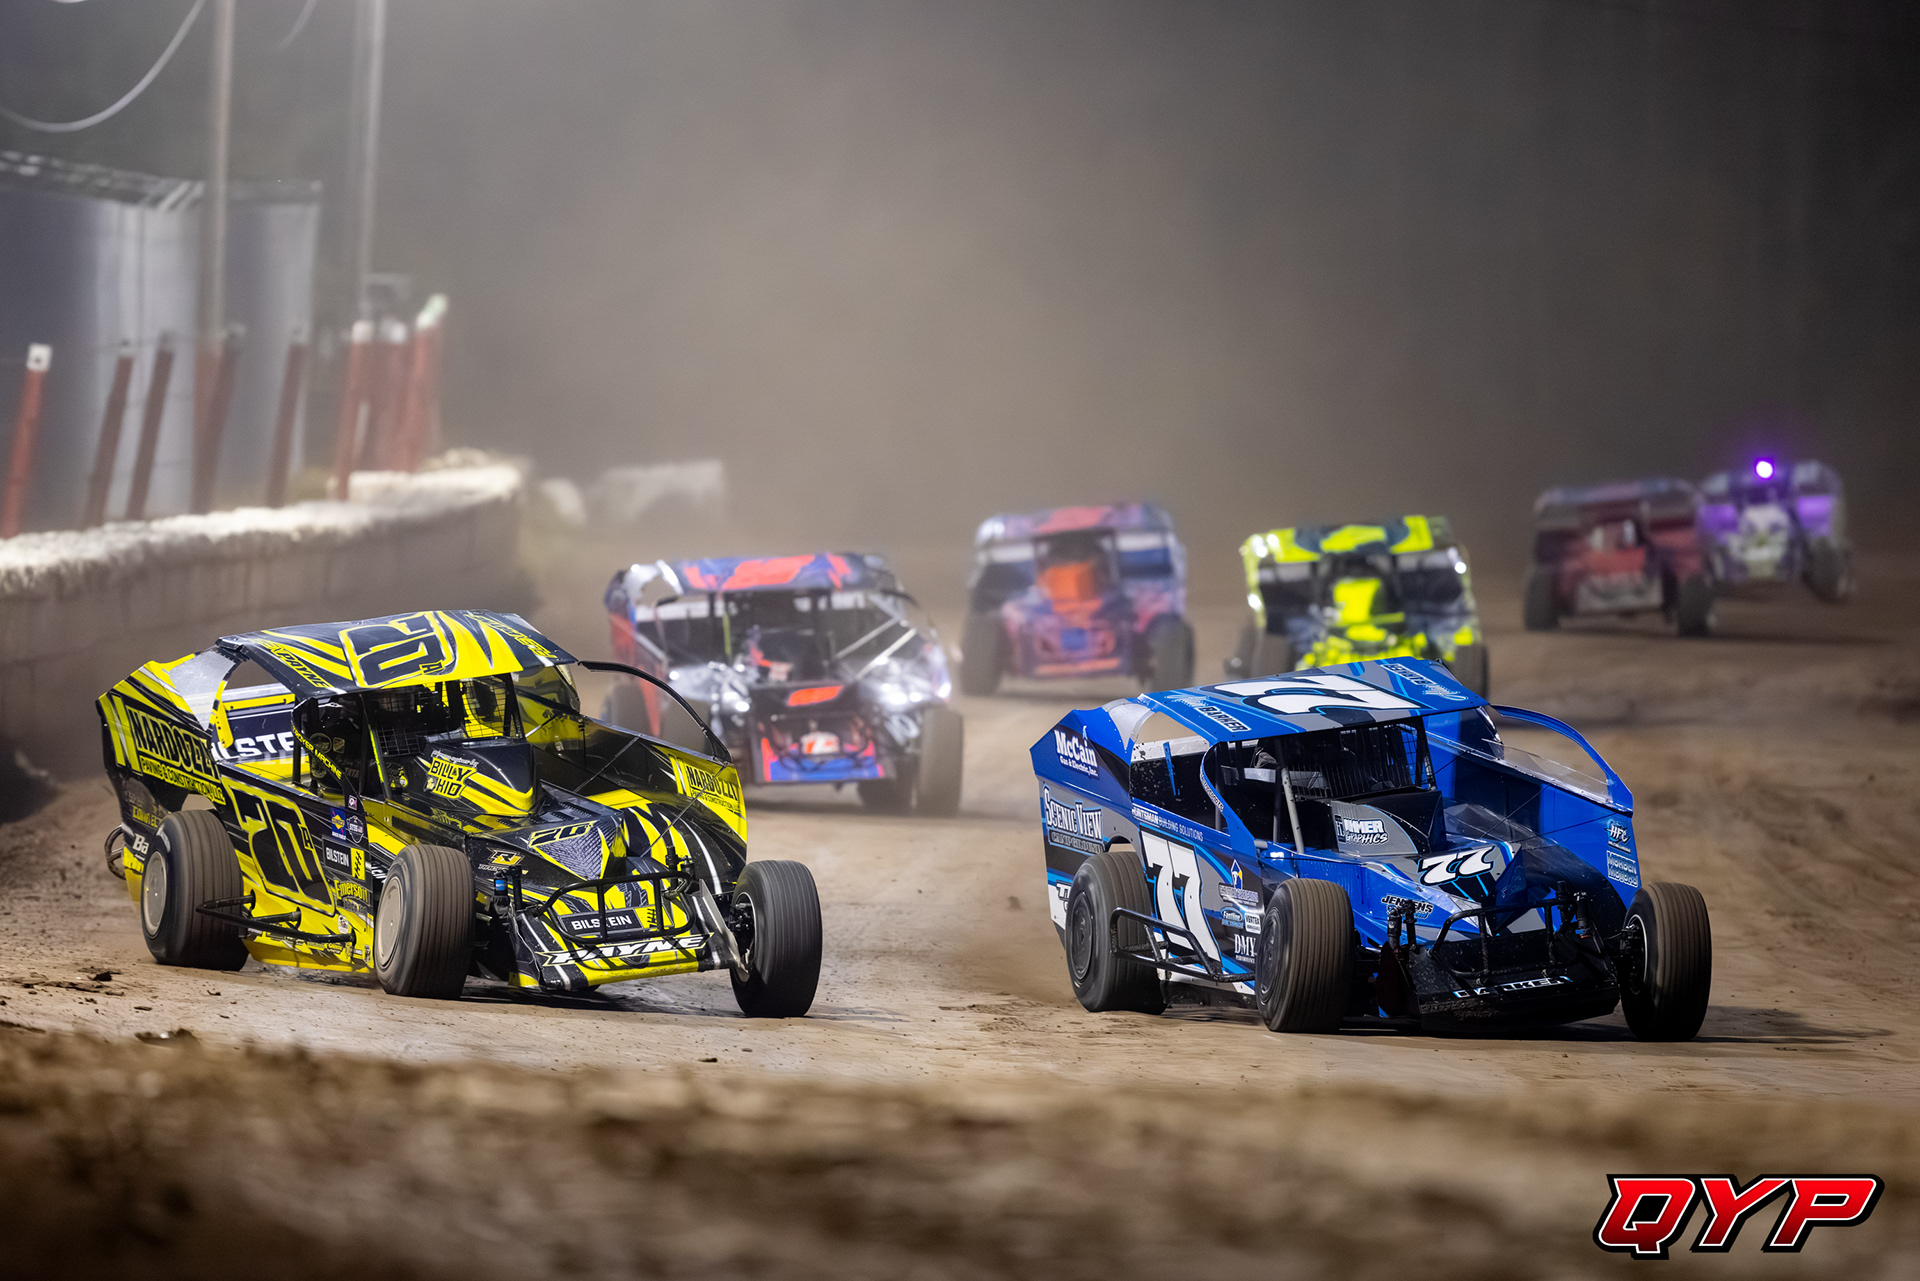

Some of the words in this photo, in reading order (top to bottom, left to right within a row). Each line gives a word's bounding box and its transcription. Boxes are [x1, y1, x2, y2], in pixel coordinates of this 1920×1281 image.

[347, 614, 442, 686] 20
[278, 652, 329, 686] PAYNE
[1202, 706, 1246, 732] BARKER
[1054, 730, 1098, 767] McCain
[315, 748, 343, 780] MACHINE
[431, 761, 472, 781] BILLY
[436, 779, 462, 796] KID
[1044, 787, 1078, 833] SCENIC
[1075, 804, 1102, 839] VIEW
[227, 784, 332, 906] 20
[529, 822, 595, 847] 20
[1179, 824, 1204, 842] SOLUTIONS
[1345, 833, 1388, 845] GRAPHICS
[325, 847, 350, 867] BILSTEIN
[1421, 847, 1493, 884] 77
[334, 879, 368, 903] Emerson
[1141, 830, 1220, 961] 77
[572, 915, 633, 931] BILSEIN
[551, 936, 704, 964] PAYNE
